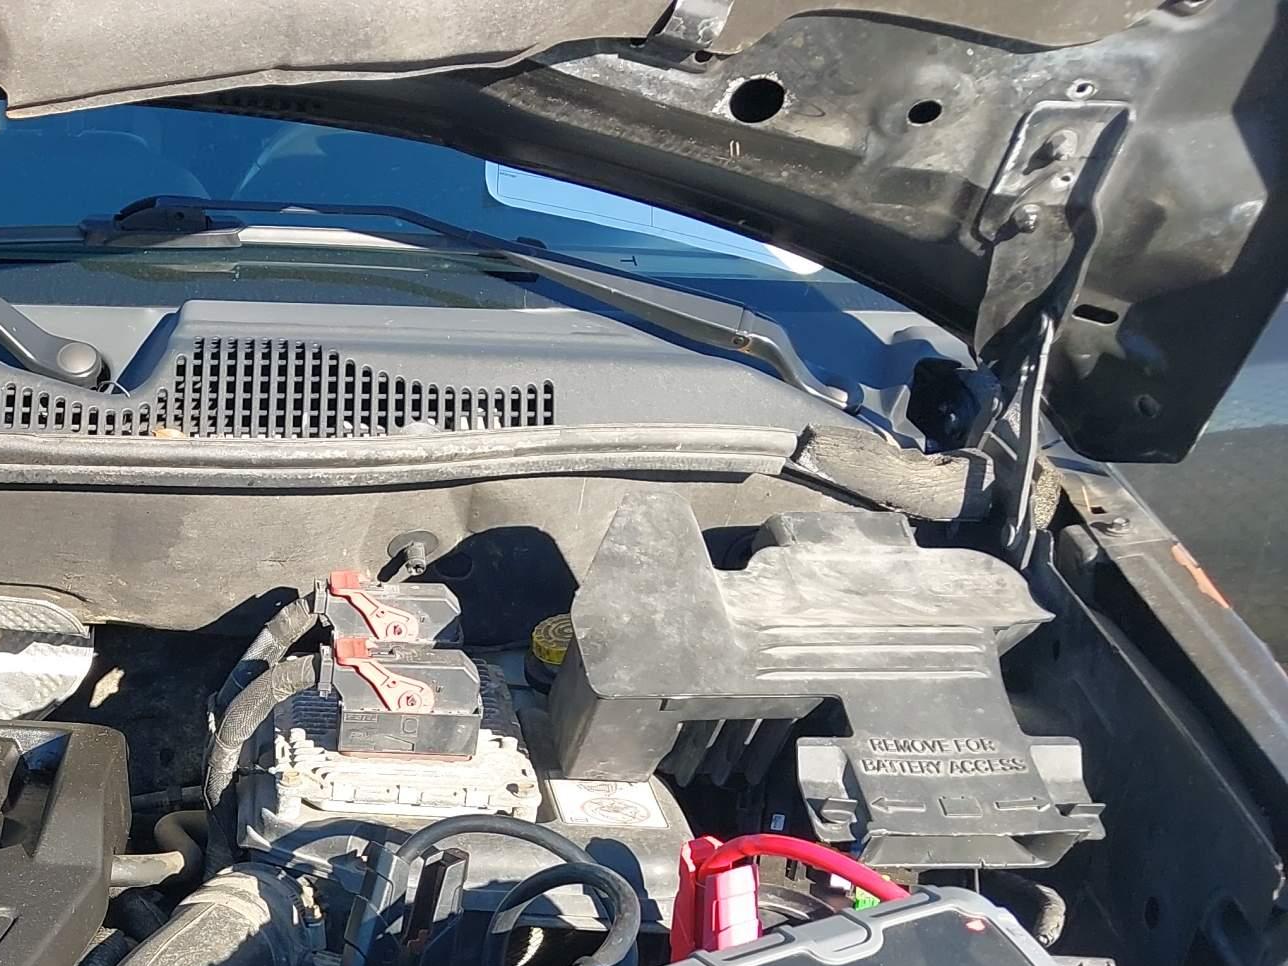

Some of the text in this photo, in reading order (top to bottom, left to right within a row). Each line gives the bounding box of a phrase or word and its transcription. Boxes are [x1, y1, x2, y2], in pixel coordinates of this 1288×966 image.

[868, 737, 997, 754] REMOVE FOR
[861, 758, 1028, 775] BATTERY ACCESS
